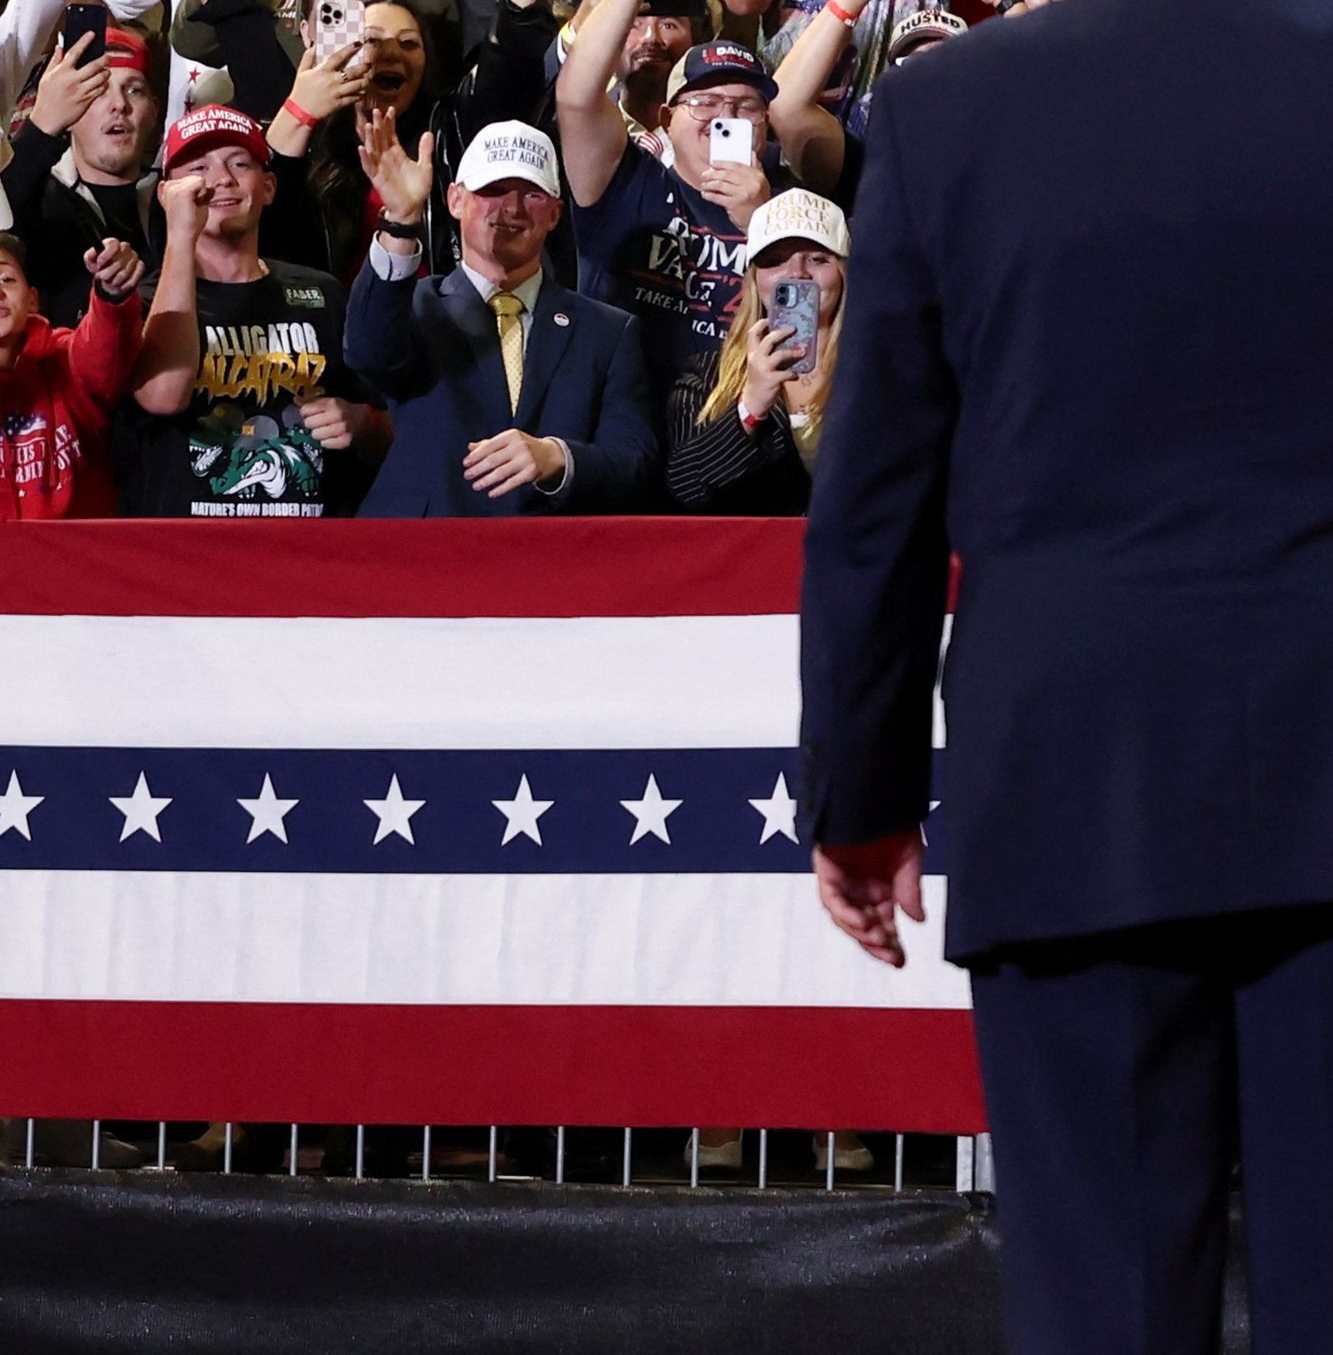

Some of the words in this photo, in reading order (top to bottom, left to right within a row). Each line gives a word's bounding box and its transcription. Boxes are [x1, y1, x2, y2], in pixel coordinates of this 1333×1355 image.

[900, 14, 962, 34] HUSTED
[716, 46, 755, 63] DAVID
[178, 110, 208, 131] MAKE
[208, 107, 253, 130] AMERICA
[181, 120, 218, 140] GREAT
[218, 119, 250, 135] AGAIN
[485, 137, 511, 151] MAKE
[511, 136, 549, 161] AMERICA
[486, 148, 516, 164] GREAT
[517, 151, 546, 170] AGAIN
[768, 193, 831, 213] TRUMP
[767, 206, 830, 225] FORCE
[764, 220, 831, 236] CAPTAIN
[666, 216, 747, 277] RUM
[648, 235, 716, 308] VACE
[286, 288, 321, 300] FABER
[635, 287, 674, 311] TAKE
[205, 323, 320, 357] ALLIGATOR
[193, 350, 327, 399] ALCATRAZ
[191, 502, 236, 516] NATURE'S
[236, 503, 261, 517] OWN
[261, 503, 300, 517] BORDER
